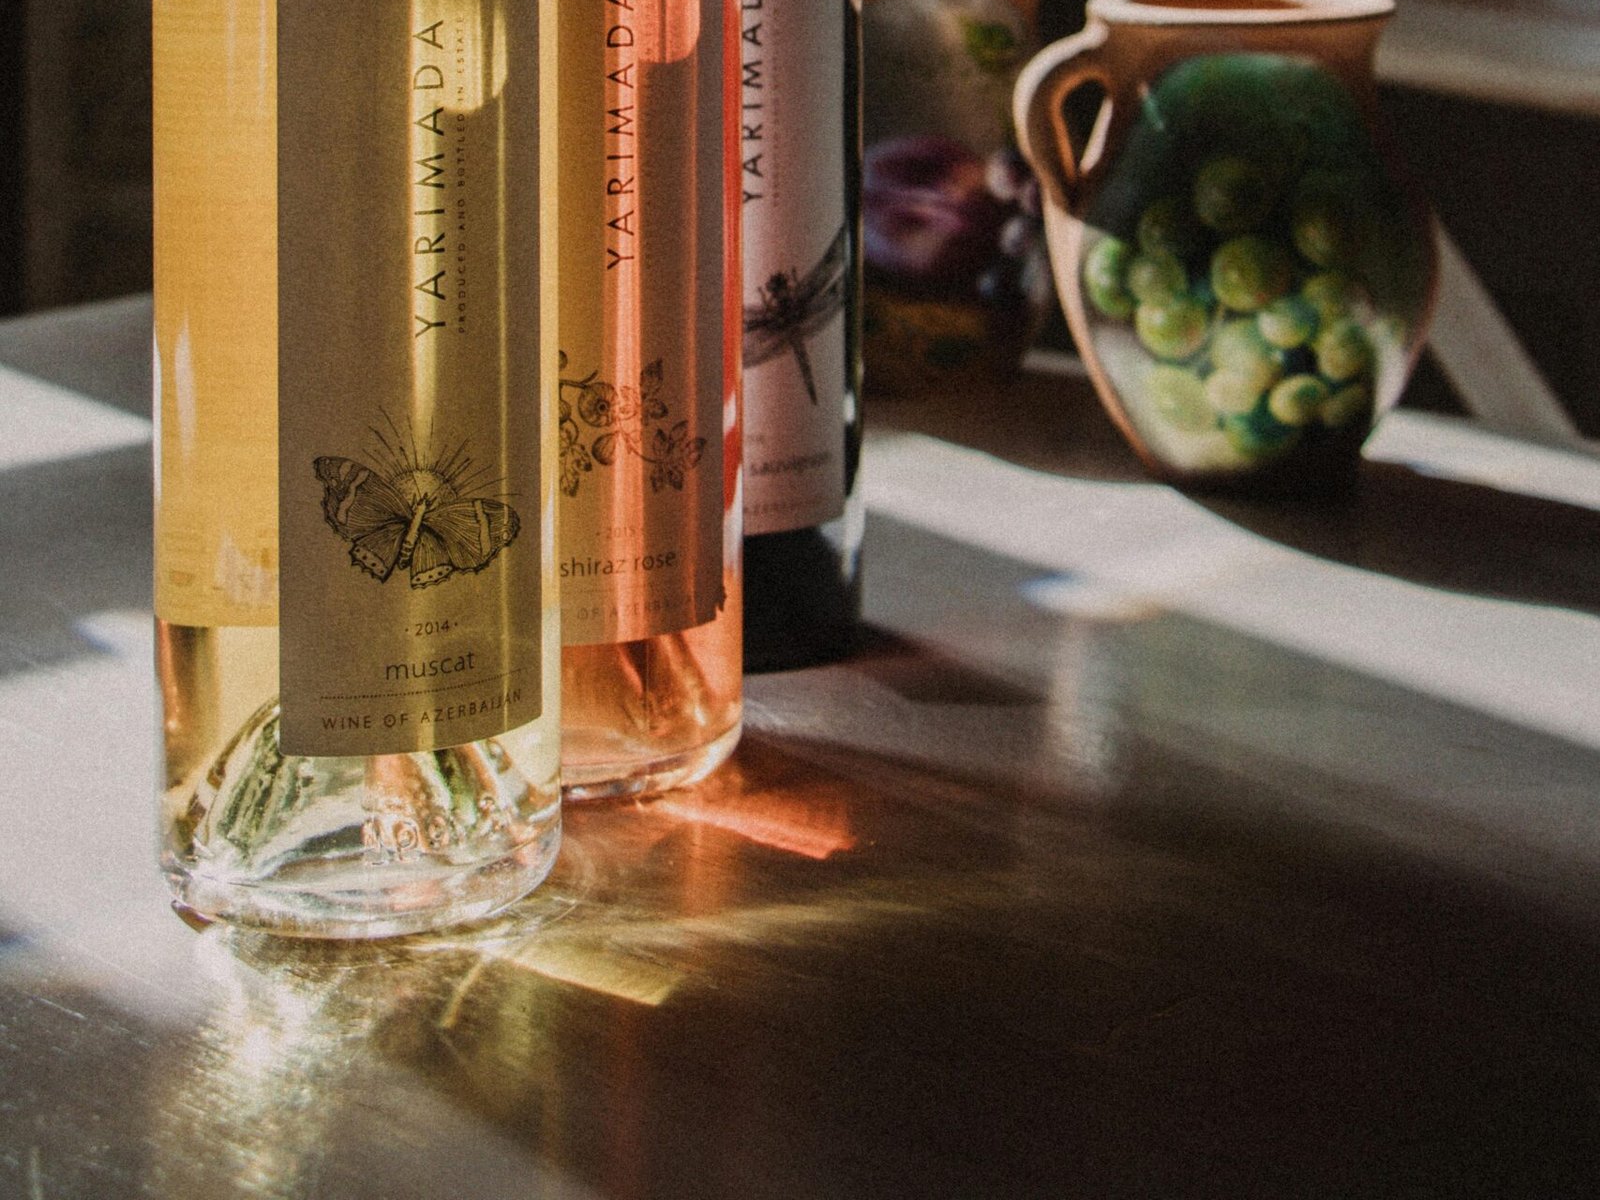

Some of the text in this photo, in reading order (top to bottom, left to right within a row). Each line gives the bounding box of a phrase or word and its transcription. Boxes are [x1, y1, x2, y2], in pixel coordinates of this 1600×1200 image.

[456, 85, 465, 103] IN
[457, 112, 466, 187] BOTTLED
[412, 19, 446, 339] YARIMADA
[457, 199, 466, 231] AND
[457, 243, 467, 334] PRODUCED
[559, 551, 677, 578] shiraz rose
[414, 619, 451, 637] 2014
[384, 651, 476, 681] muscat
[321, 688, 523, 731] WINE OF AZERBAIJAN
